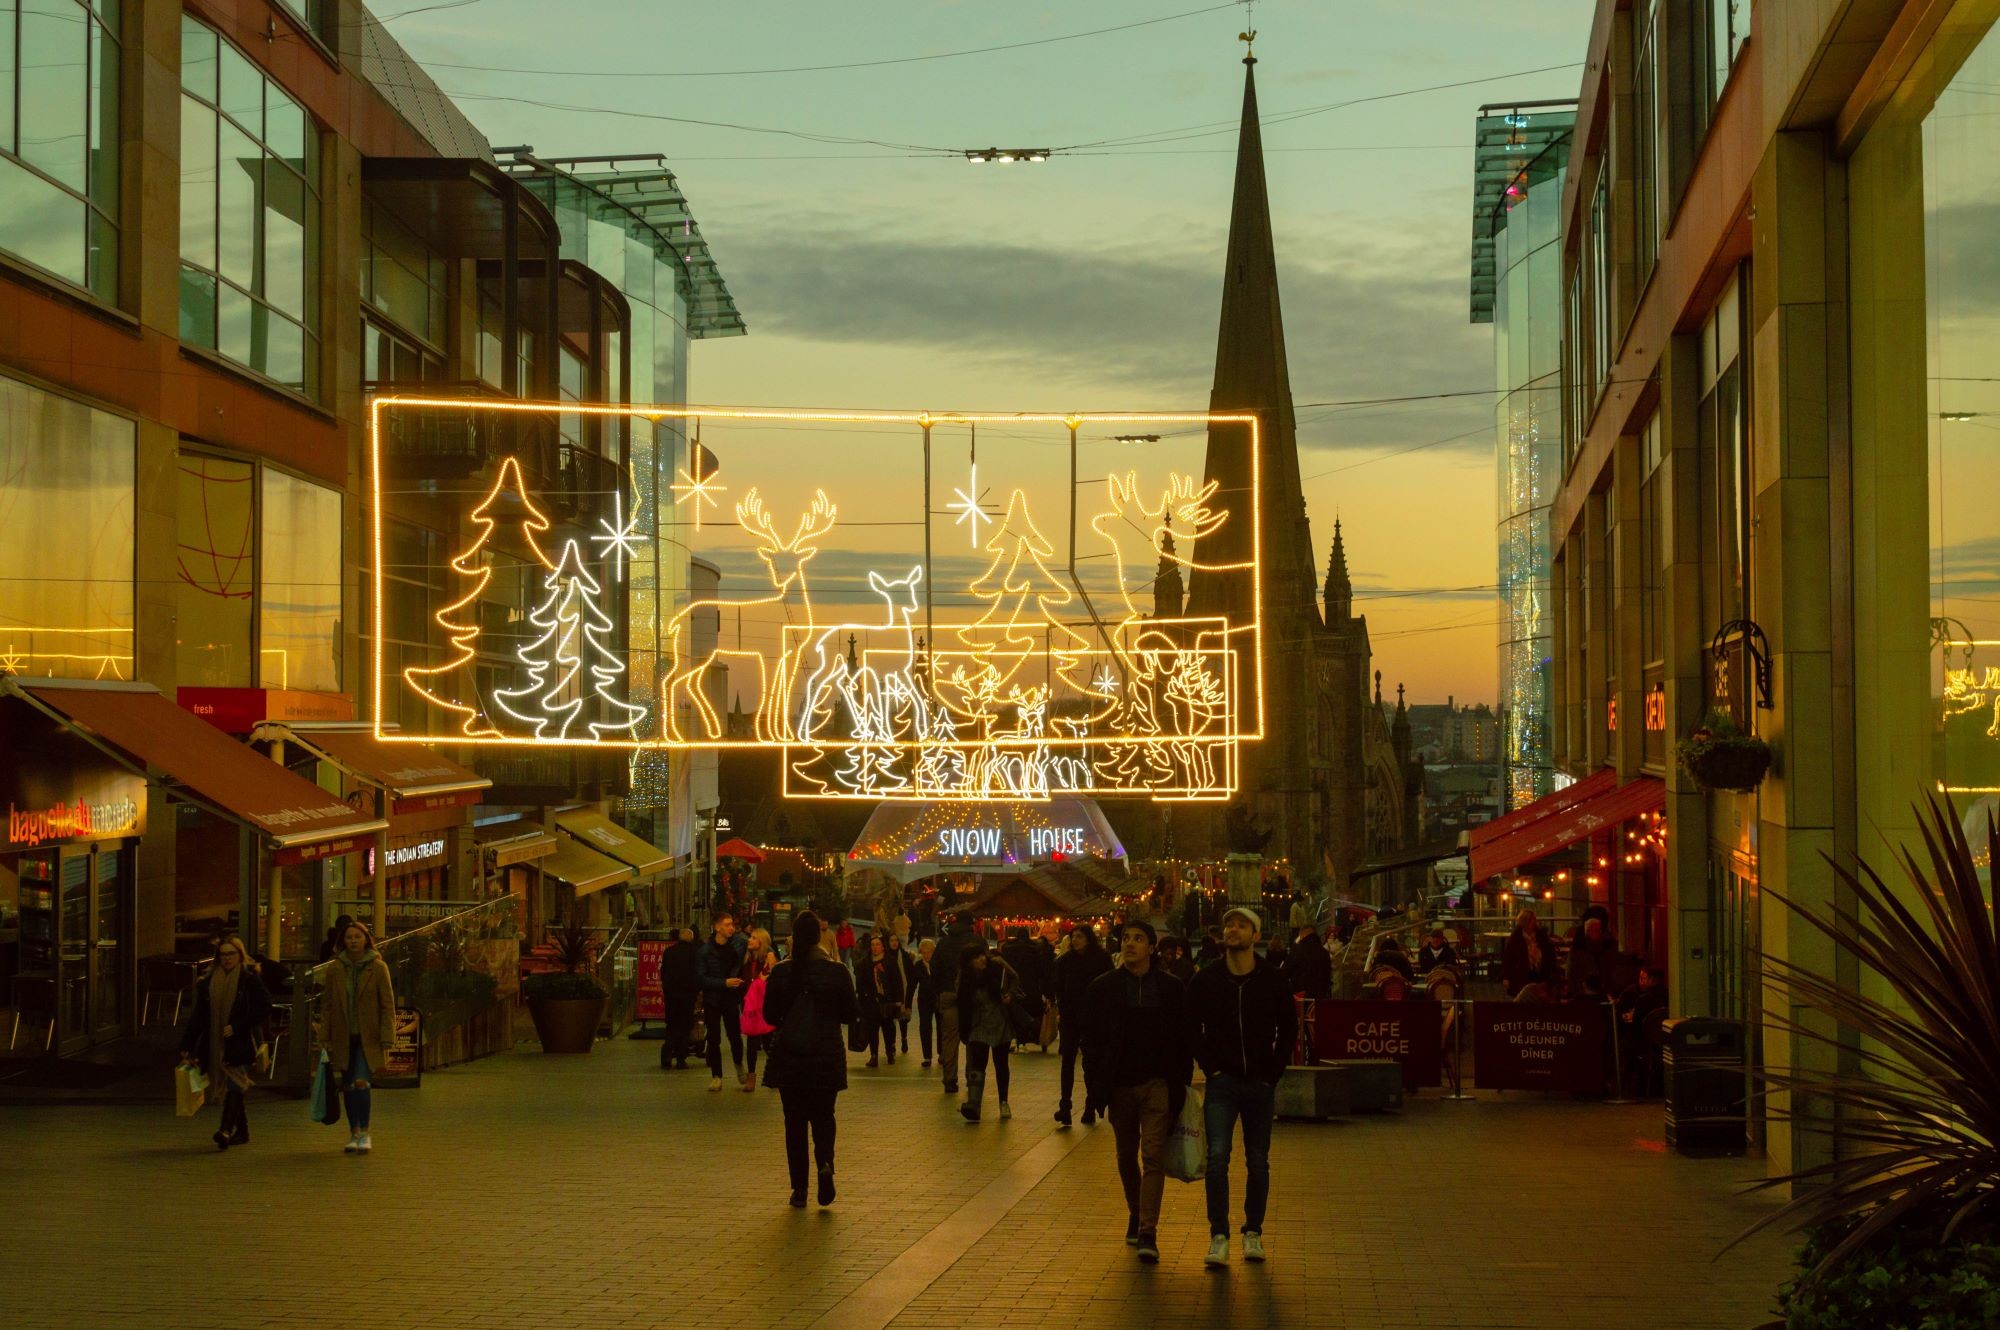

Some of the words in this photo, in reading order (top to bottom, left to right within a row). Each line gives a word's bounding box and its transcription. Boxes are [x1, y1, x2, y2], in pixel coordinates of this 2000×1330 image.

[194, 704, 214, 714] fresh
[939, 829, 1000, 856] SNOW
[1031, 828, 1083, 855] HOUSE
[385, 850, 396, 867] THE
[397, 846, 417, 864] INDIAN
[418, 840, 444, 860] STREATERY
[643, 954, 663, 964] GRA
[1354, 1020, 1401, 1037] CAFÉ
[1493, 1021, 1522, 1033] PETIT
[1526, 1019, 1583, 1034] DÉJEUNER
[1347, 1039, 1410, 1054] ROUGE
[1509, 1033, 1566, 1045] DÉJEUNER
[1521, 1047, 1554, 1059] DÎNER
